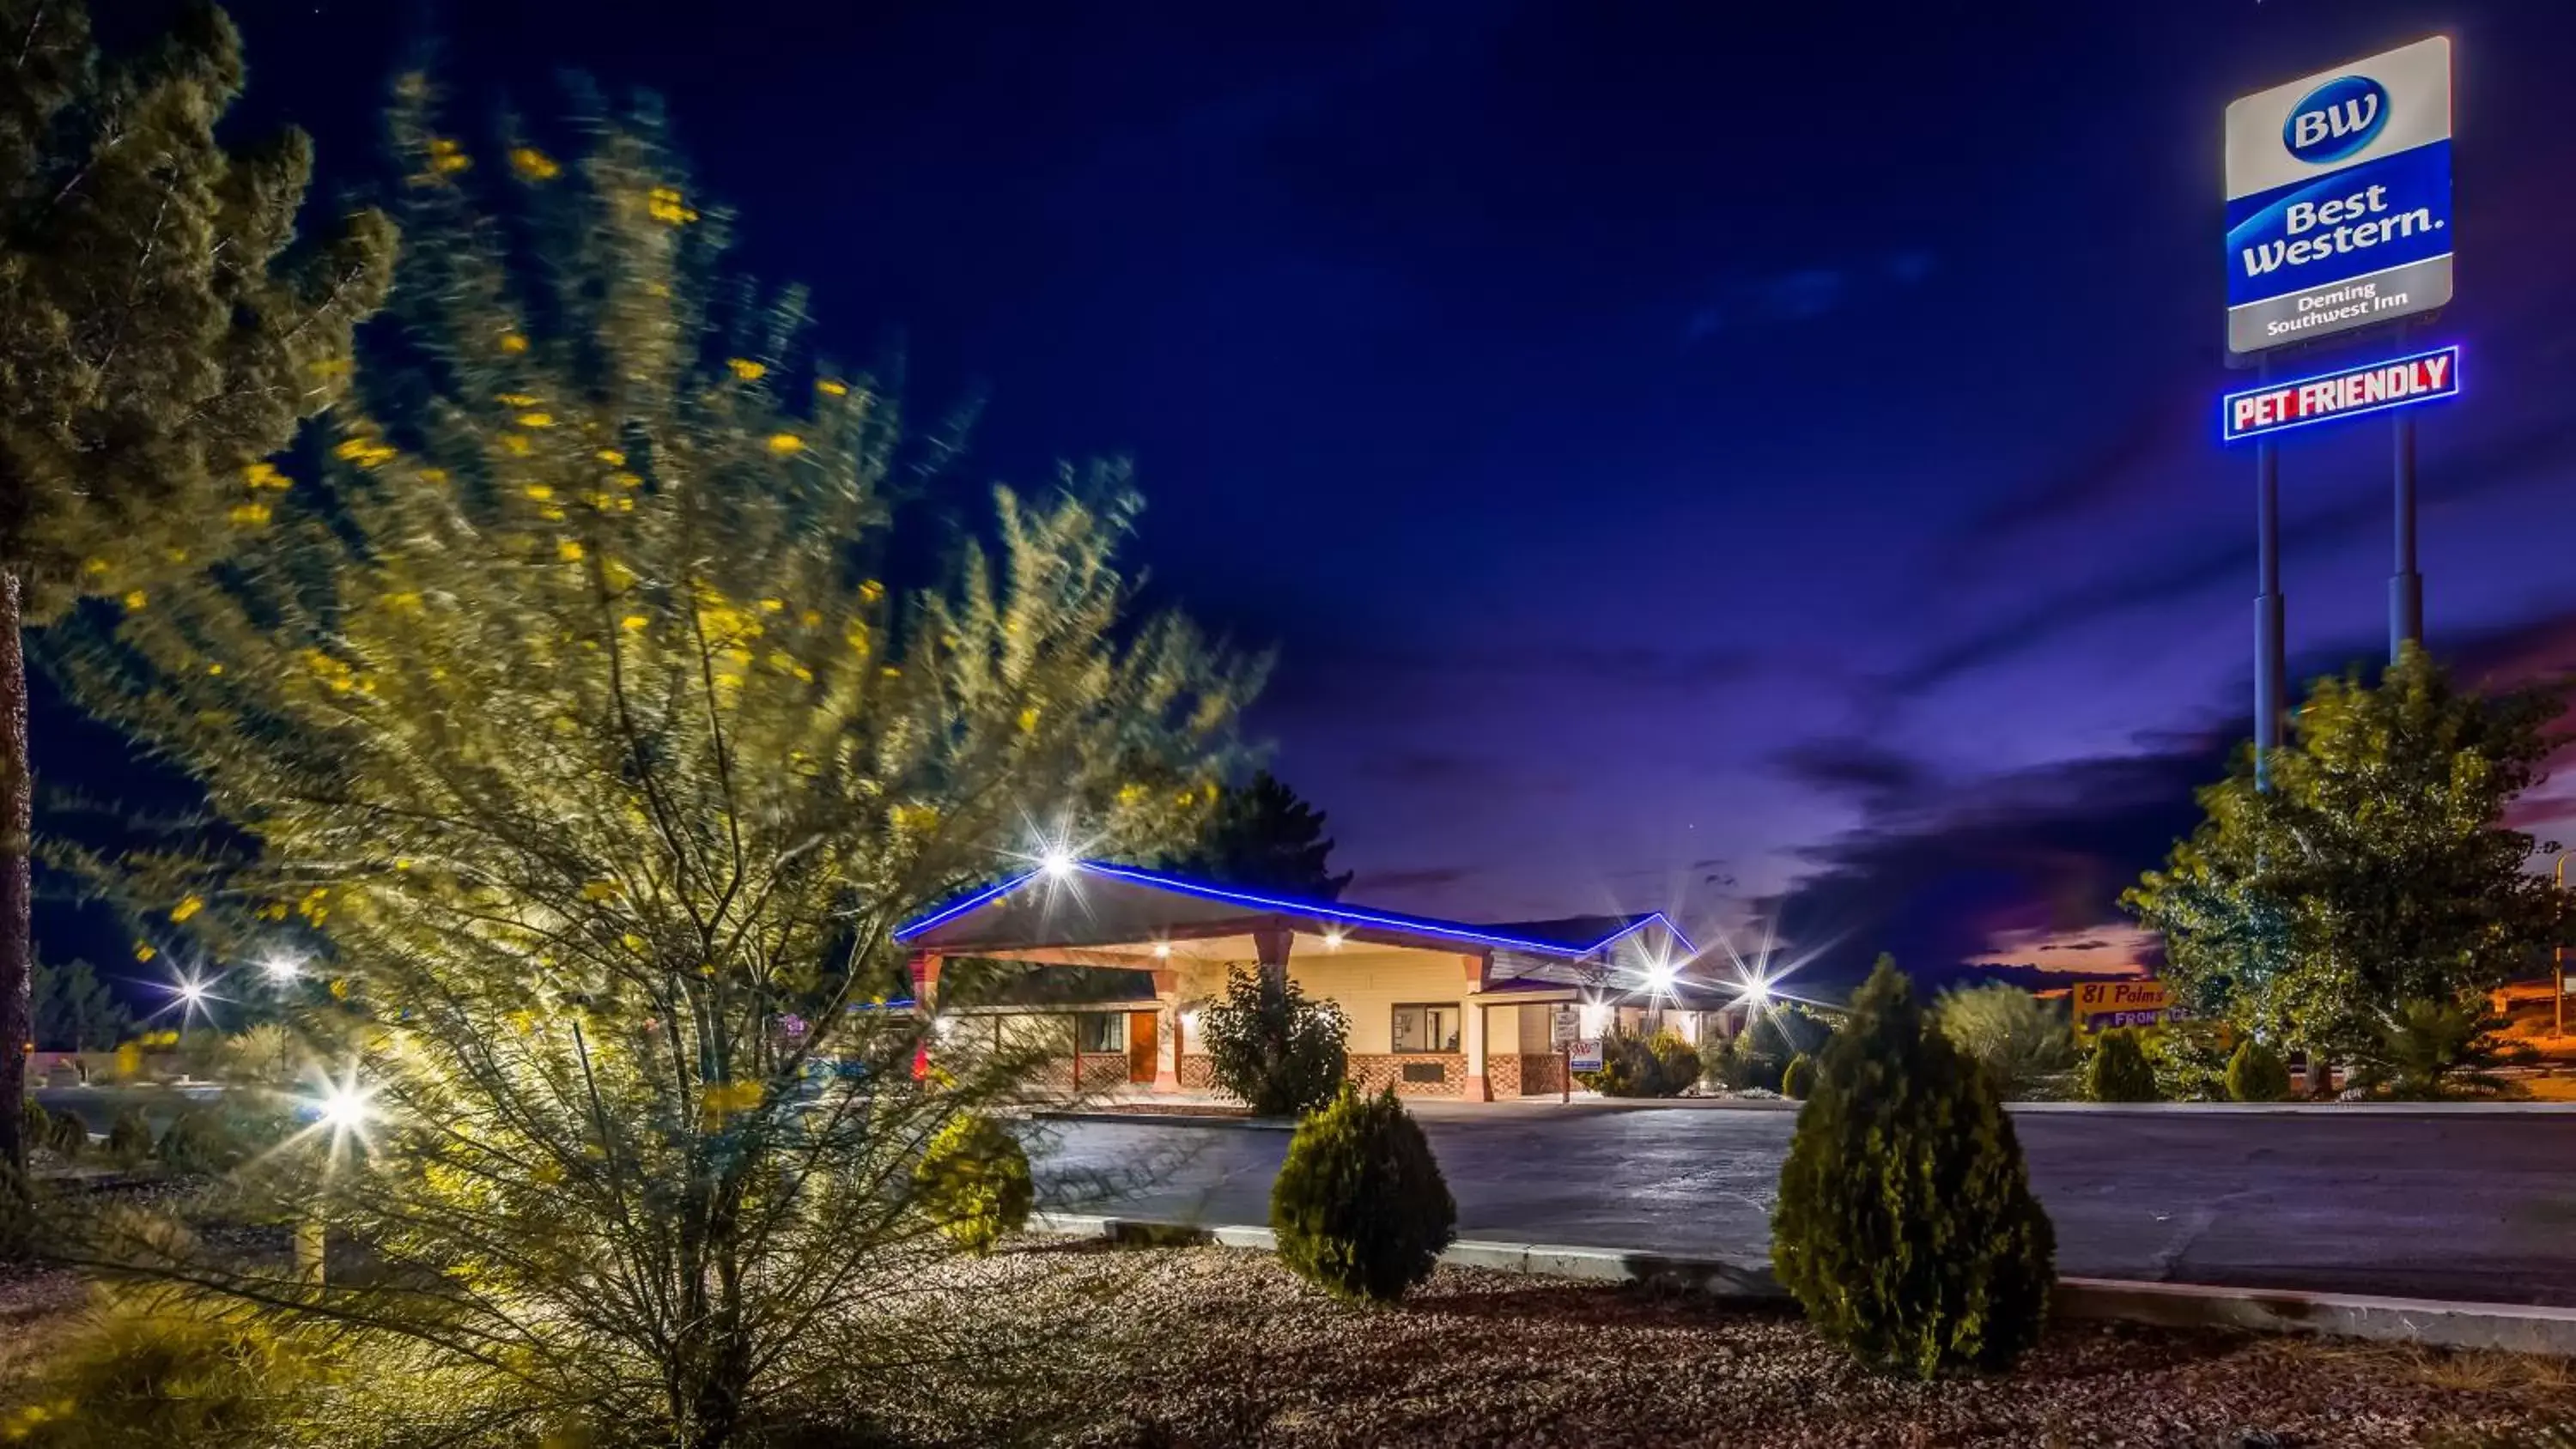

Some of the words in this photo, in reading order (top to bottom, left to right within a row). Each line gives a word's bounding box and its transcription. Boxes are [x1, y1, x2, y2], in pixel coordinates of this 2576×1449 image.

[2295, 94, 2378, 149] BW
[2287, 185, 2388, 236] Best
[2267, 300, 2369, 336] Southwest
[2374, 293, 2409, 311] Inn
[2298, 282, 2377, 312] Deming
[2235, 391, 2292, 430] PET
[2299, 356, 2447, 416] FRIENDLY
[2114, 985, 2166, 1003] Palms
